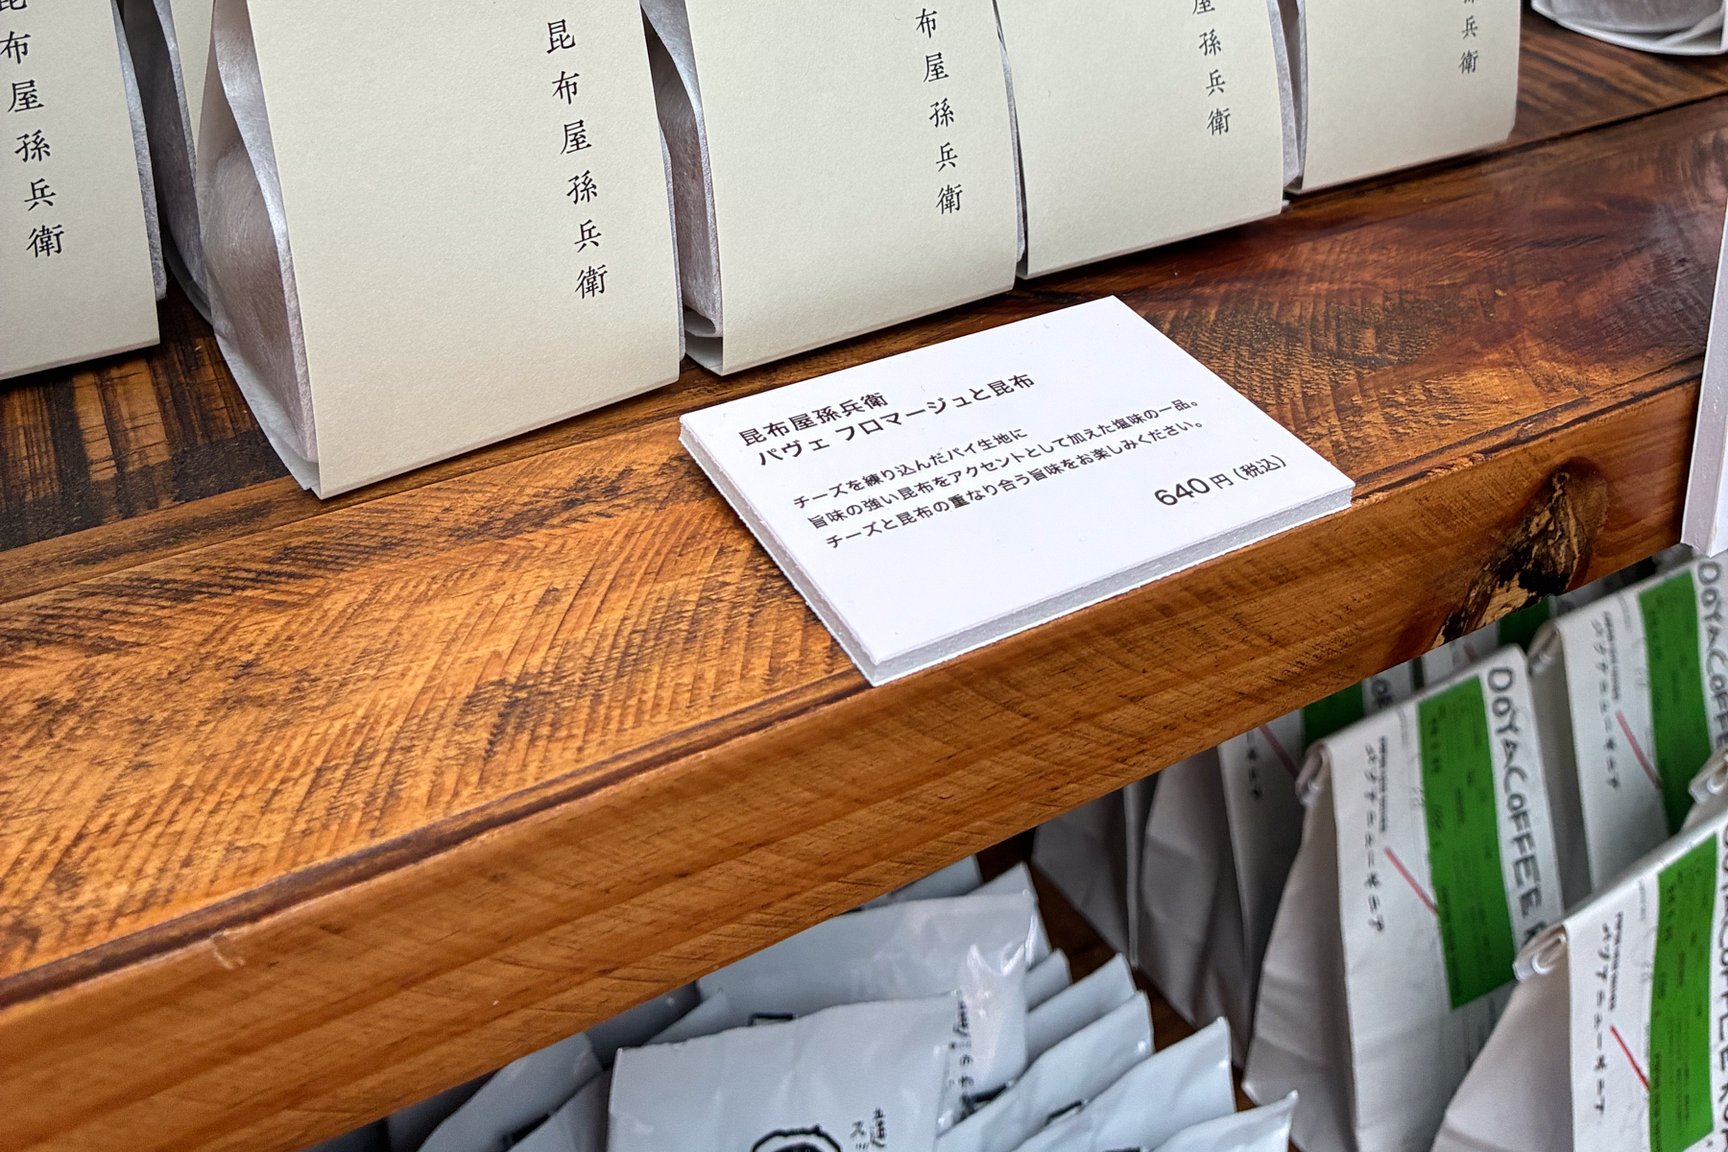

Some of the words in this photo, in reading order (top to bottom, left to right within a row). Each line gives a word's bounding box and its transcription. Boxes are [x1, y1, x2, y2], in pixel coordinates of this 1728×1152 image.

[546, 19, 609, 301] 昆布屋孫兵衛
[738, 391, 890, 447] 昆布屋孫兵衛
[793, 427, 1028, 509] チーズを練り込んだパイ生地に
[808, 399, 1199, 529] 旨味の強い昆布をアクセントとして加えた塩味の一品。
[826, 419, 1203, 549] チーズと昆布の重なり合う旨味をお楽しみください。
